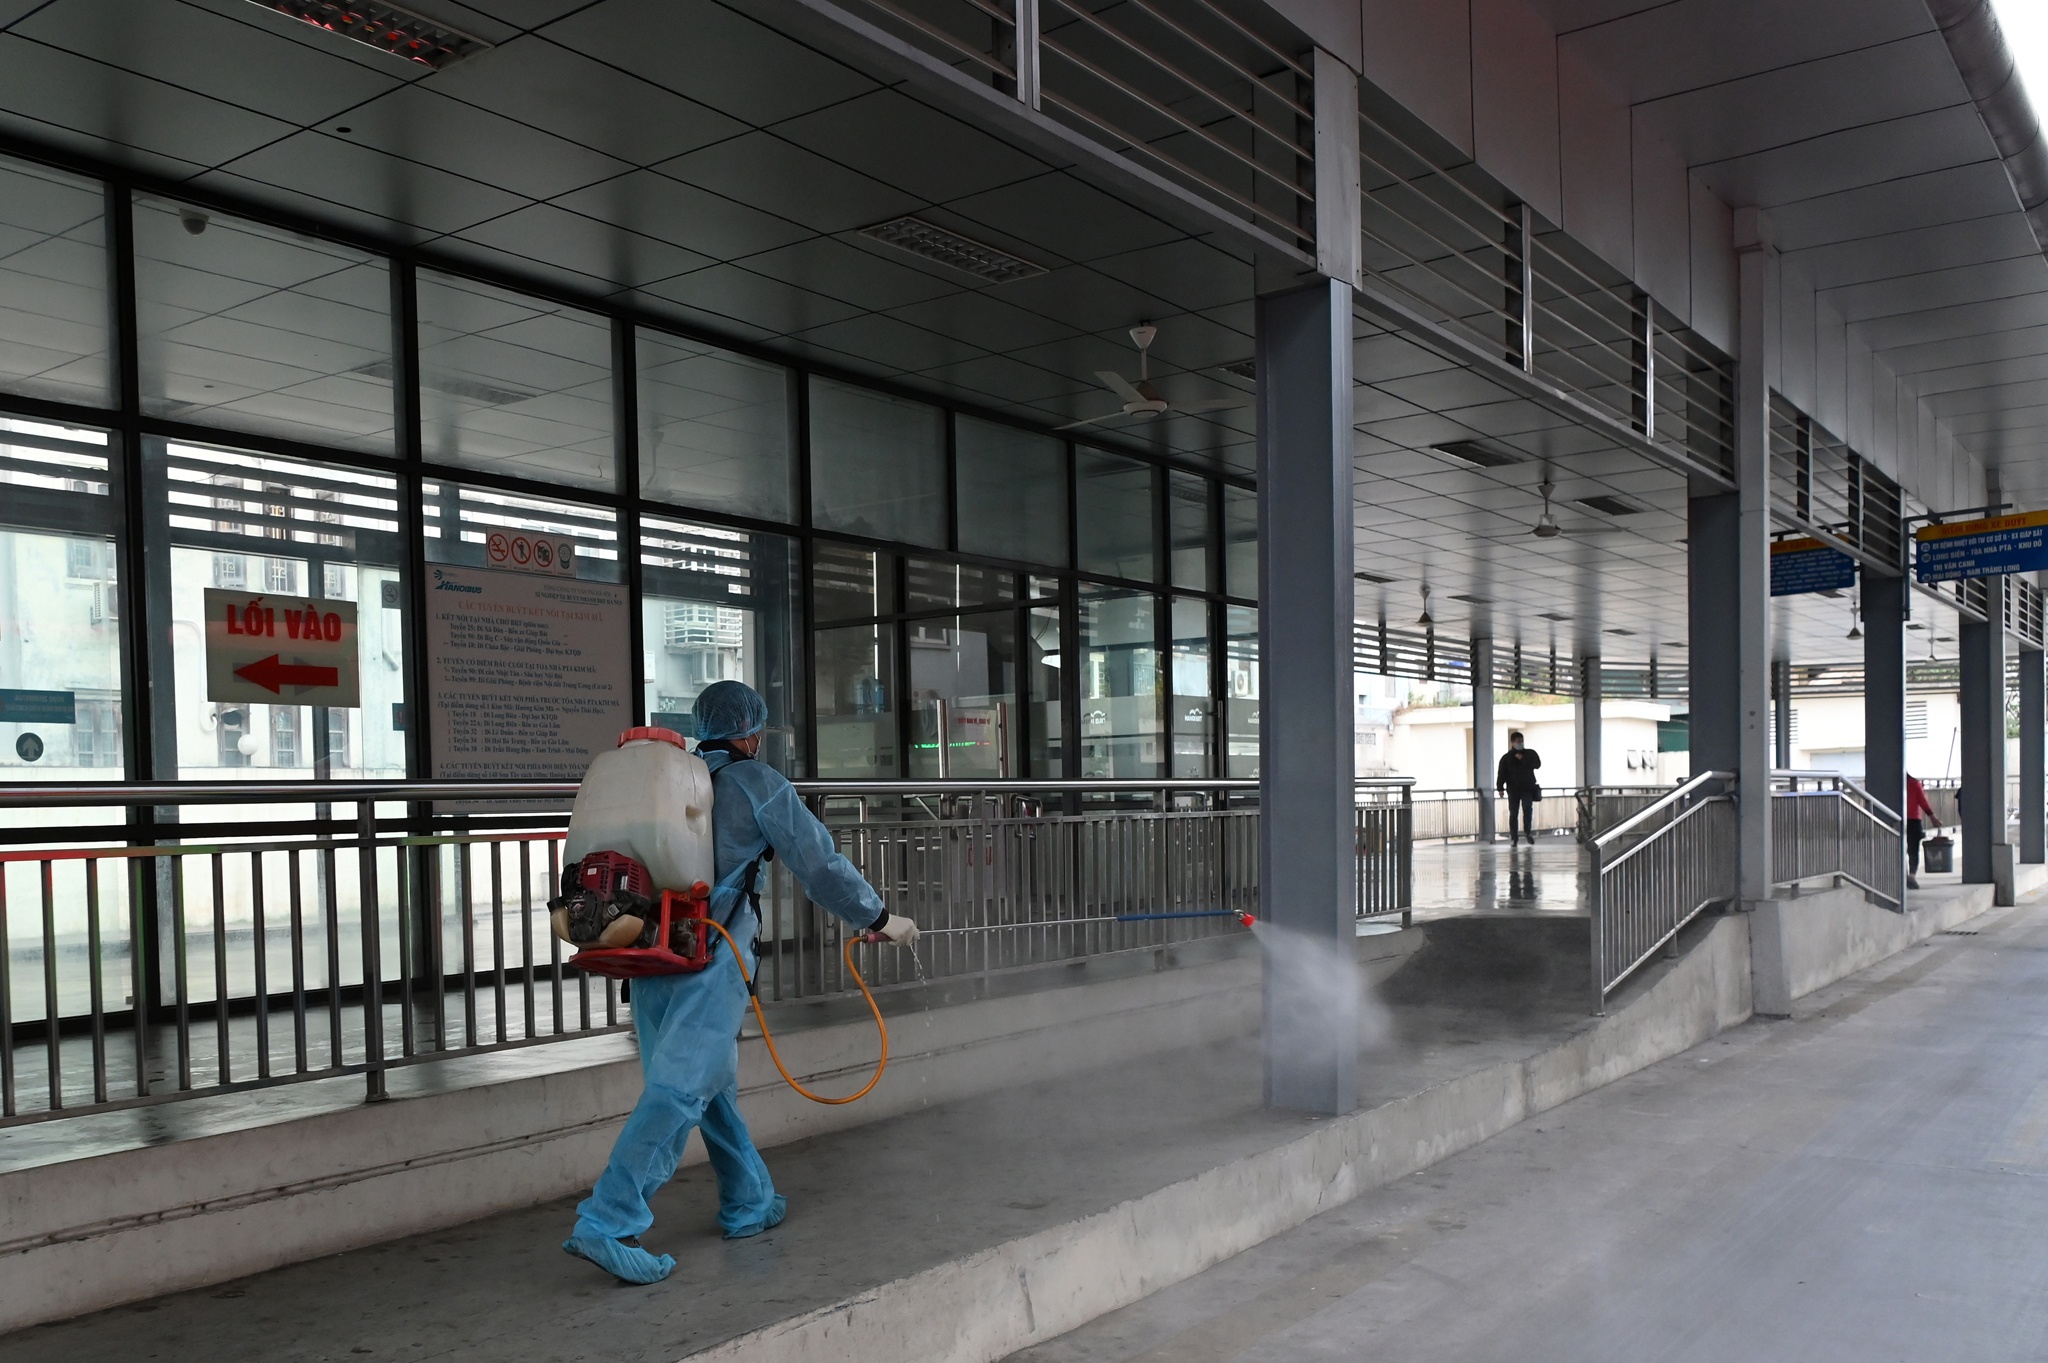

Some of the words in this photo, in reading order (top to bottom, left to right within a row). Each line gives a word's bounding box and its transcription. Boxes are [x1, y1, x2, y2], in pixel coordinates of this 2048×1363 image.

[2019, 541, 2032, 549] KHU
[434, 581, 482, 593] HANOIBUS
[227, 596, 275, 637] LỐI
[284, 604, 342, 642] VÀO
